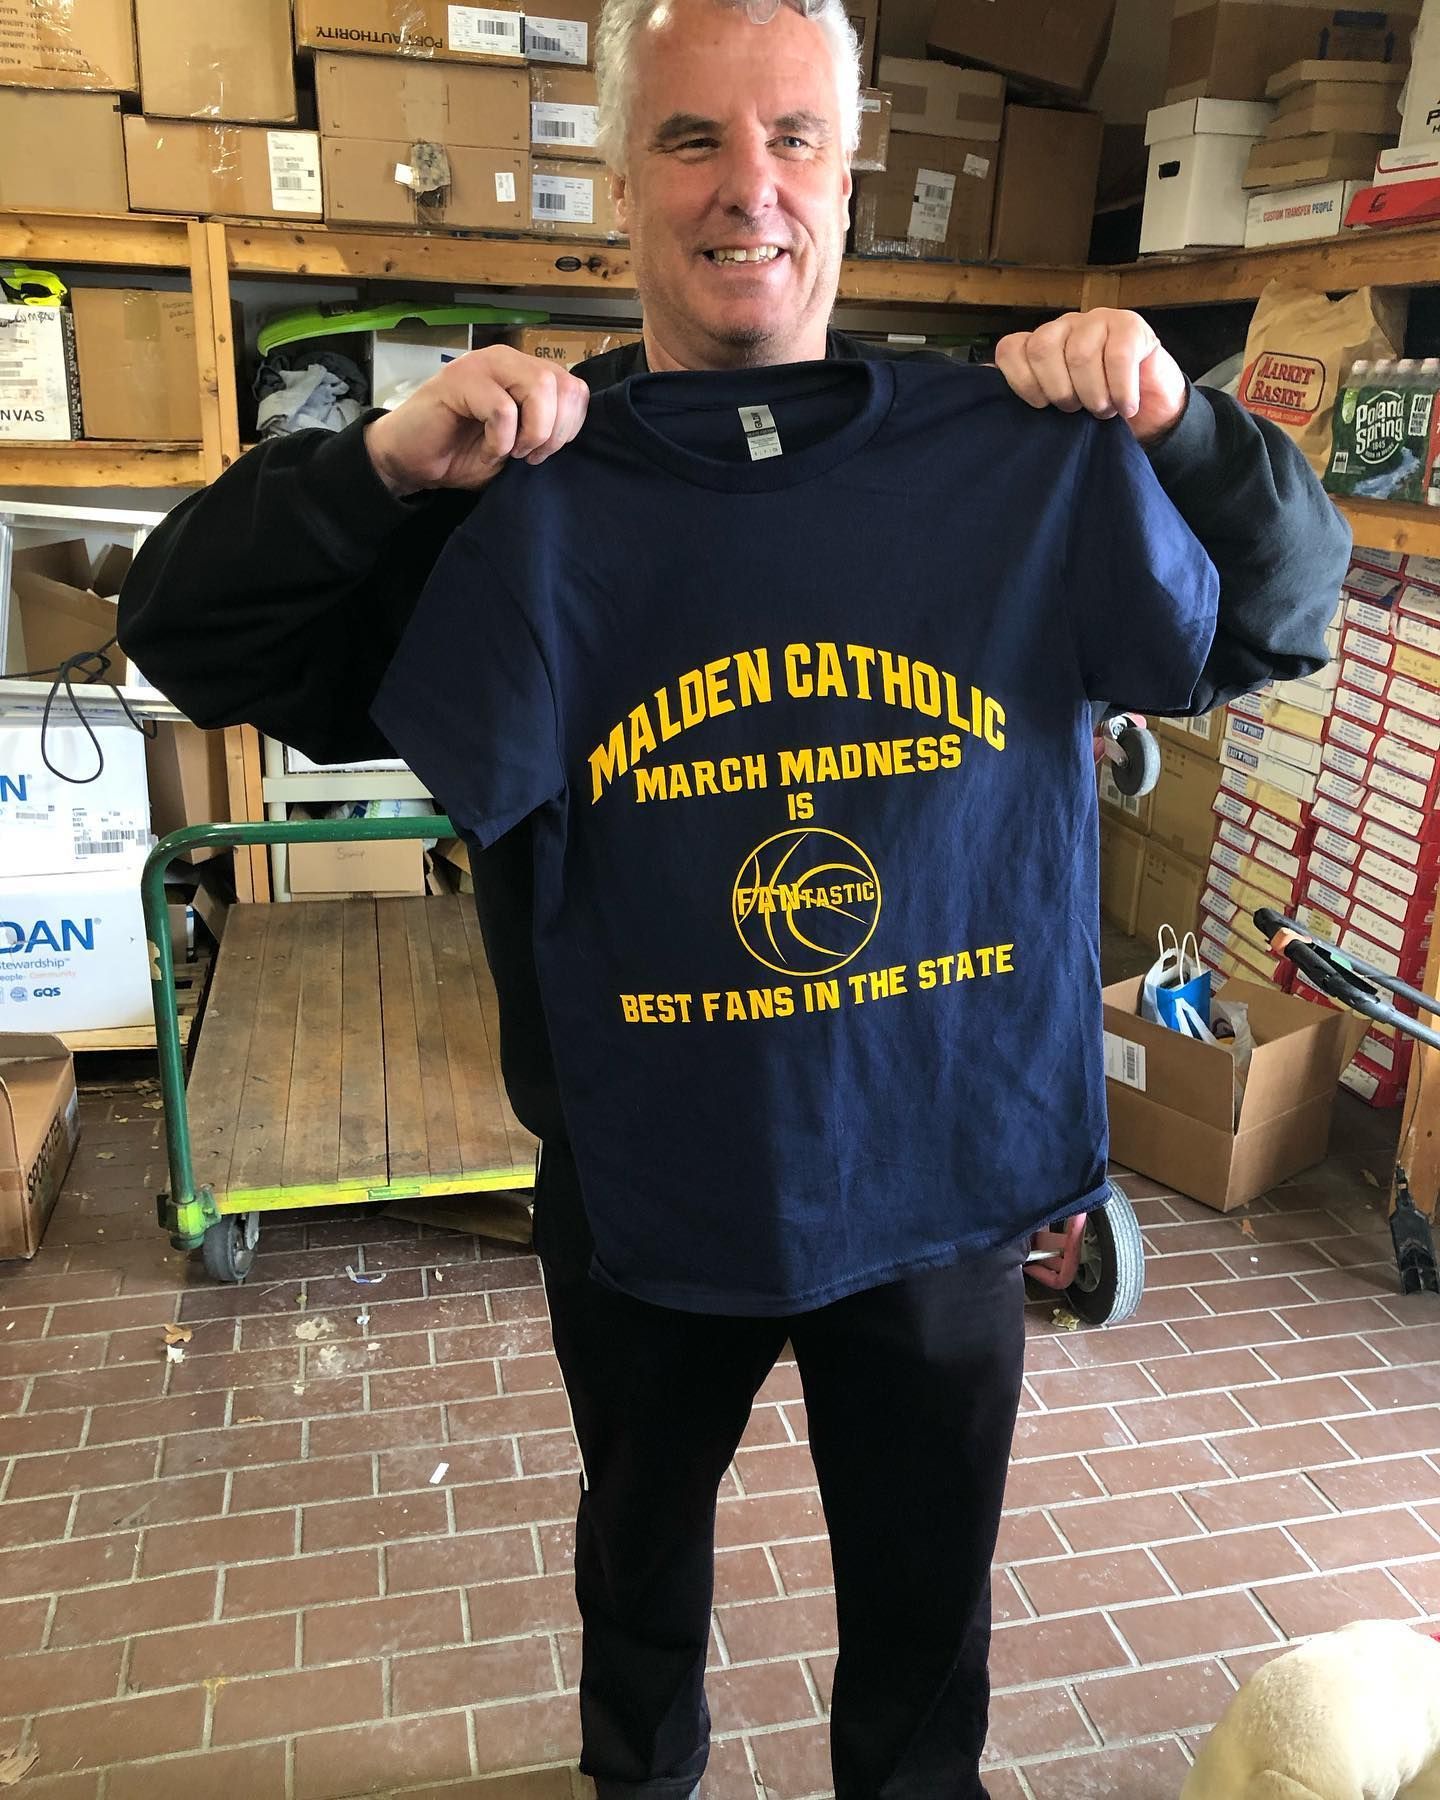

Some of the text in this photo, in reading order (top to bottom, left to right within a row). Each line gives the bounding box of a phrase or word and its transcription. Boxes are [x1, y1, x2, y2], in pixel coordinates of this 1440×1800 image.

[316, 26, 401, 45] AUTHORITY
[1263, 200, 1334, 223] CUSTOM TRANSFER PEOPLE
[1257, 356, 1316, 385] MARKET
[1251, 380, 1307, 407] BASKET
[1356, 393, 1406, 431] Poland
[1355, 417, 1404, 455] Spring
[588, 642, 1006, 805] MALDEN CATHOLIC
[633, 734, 962, 803] MARCH MADNESS
[788, 792, 815, 820] IS
[0, 957, 65, 970] tewardship
[619, 943, 1015, 1024] BEST FANS IN THE STATE
